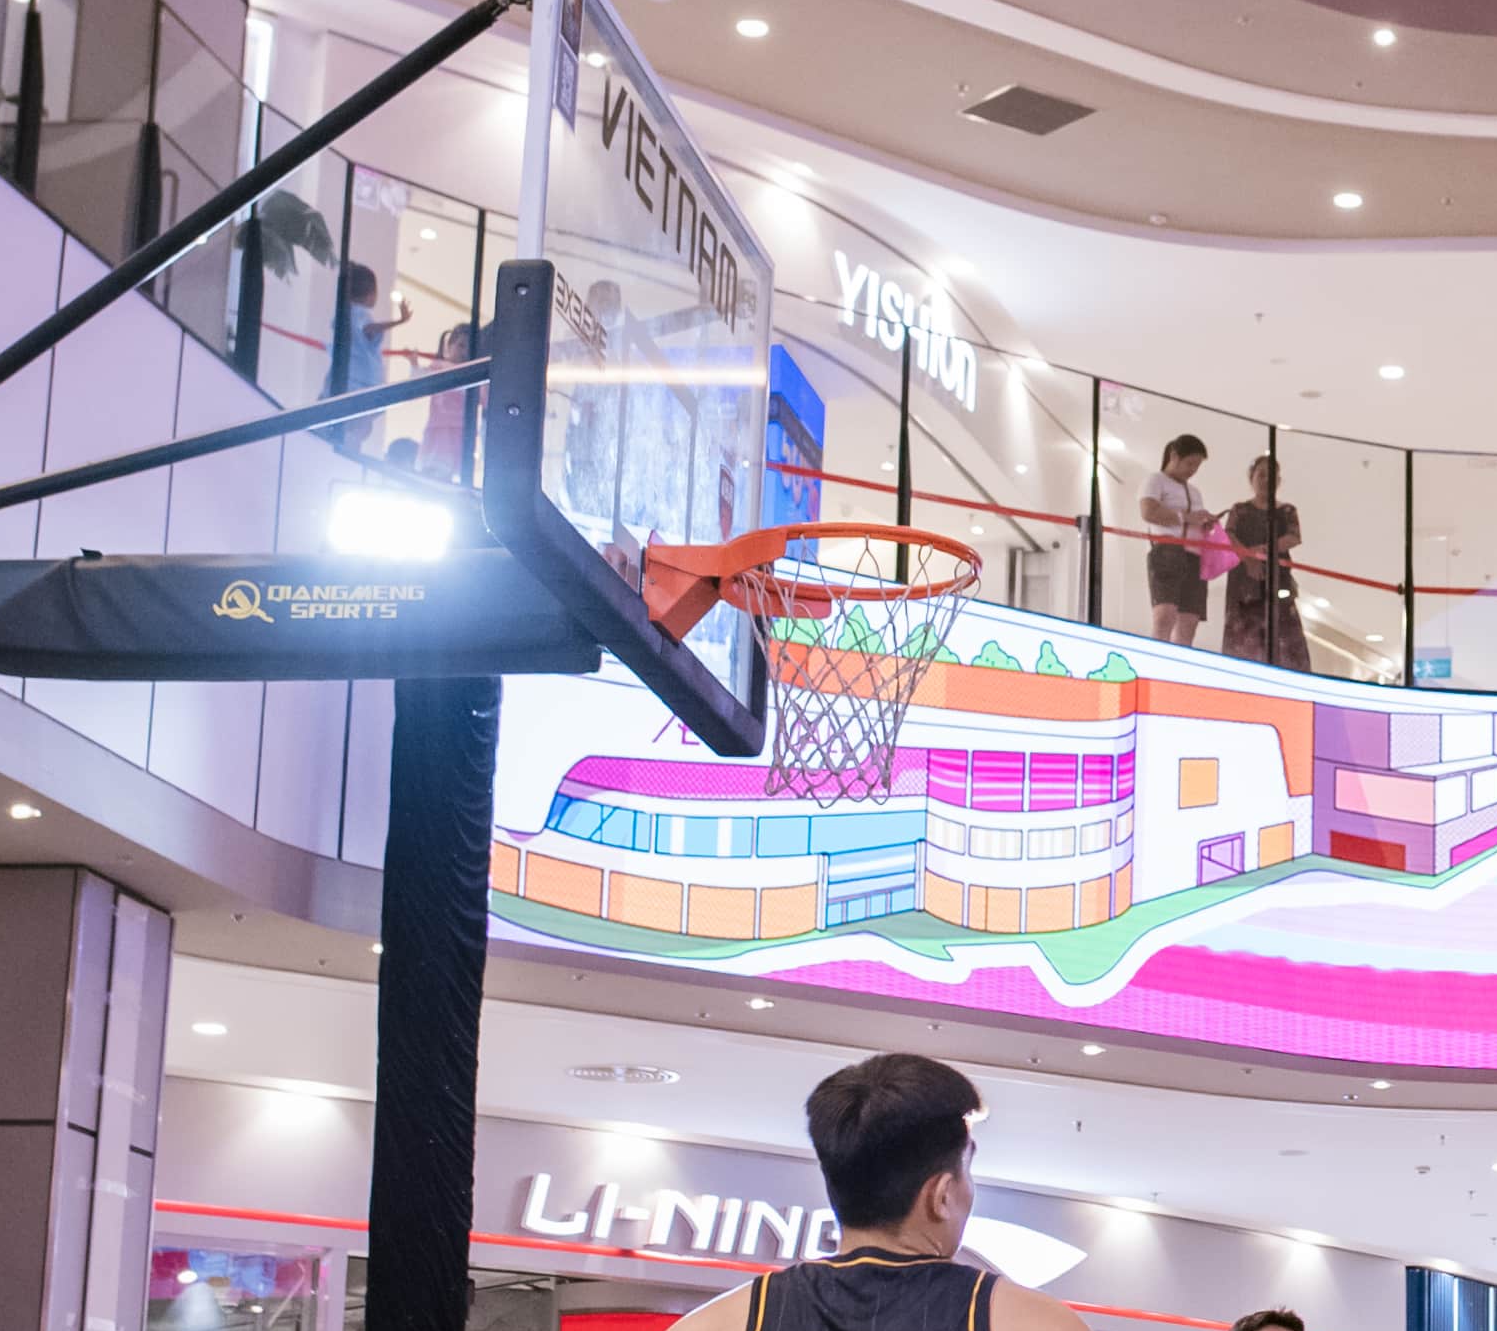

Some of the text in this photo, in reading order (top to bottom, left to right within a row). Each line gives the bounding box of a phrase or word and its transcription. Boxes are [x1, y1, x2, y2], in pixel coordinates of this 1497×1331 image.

[601, 75, 739, 335] VIETNAM
[266, 584, 425, 602] QIANGMENG
[289, 601, 398, 619] SPORTS
[521, 1171, 843, 1261] LI-NING
